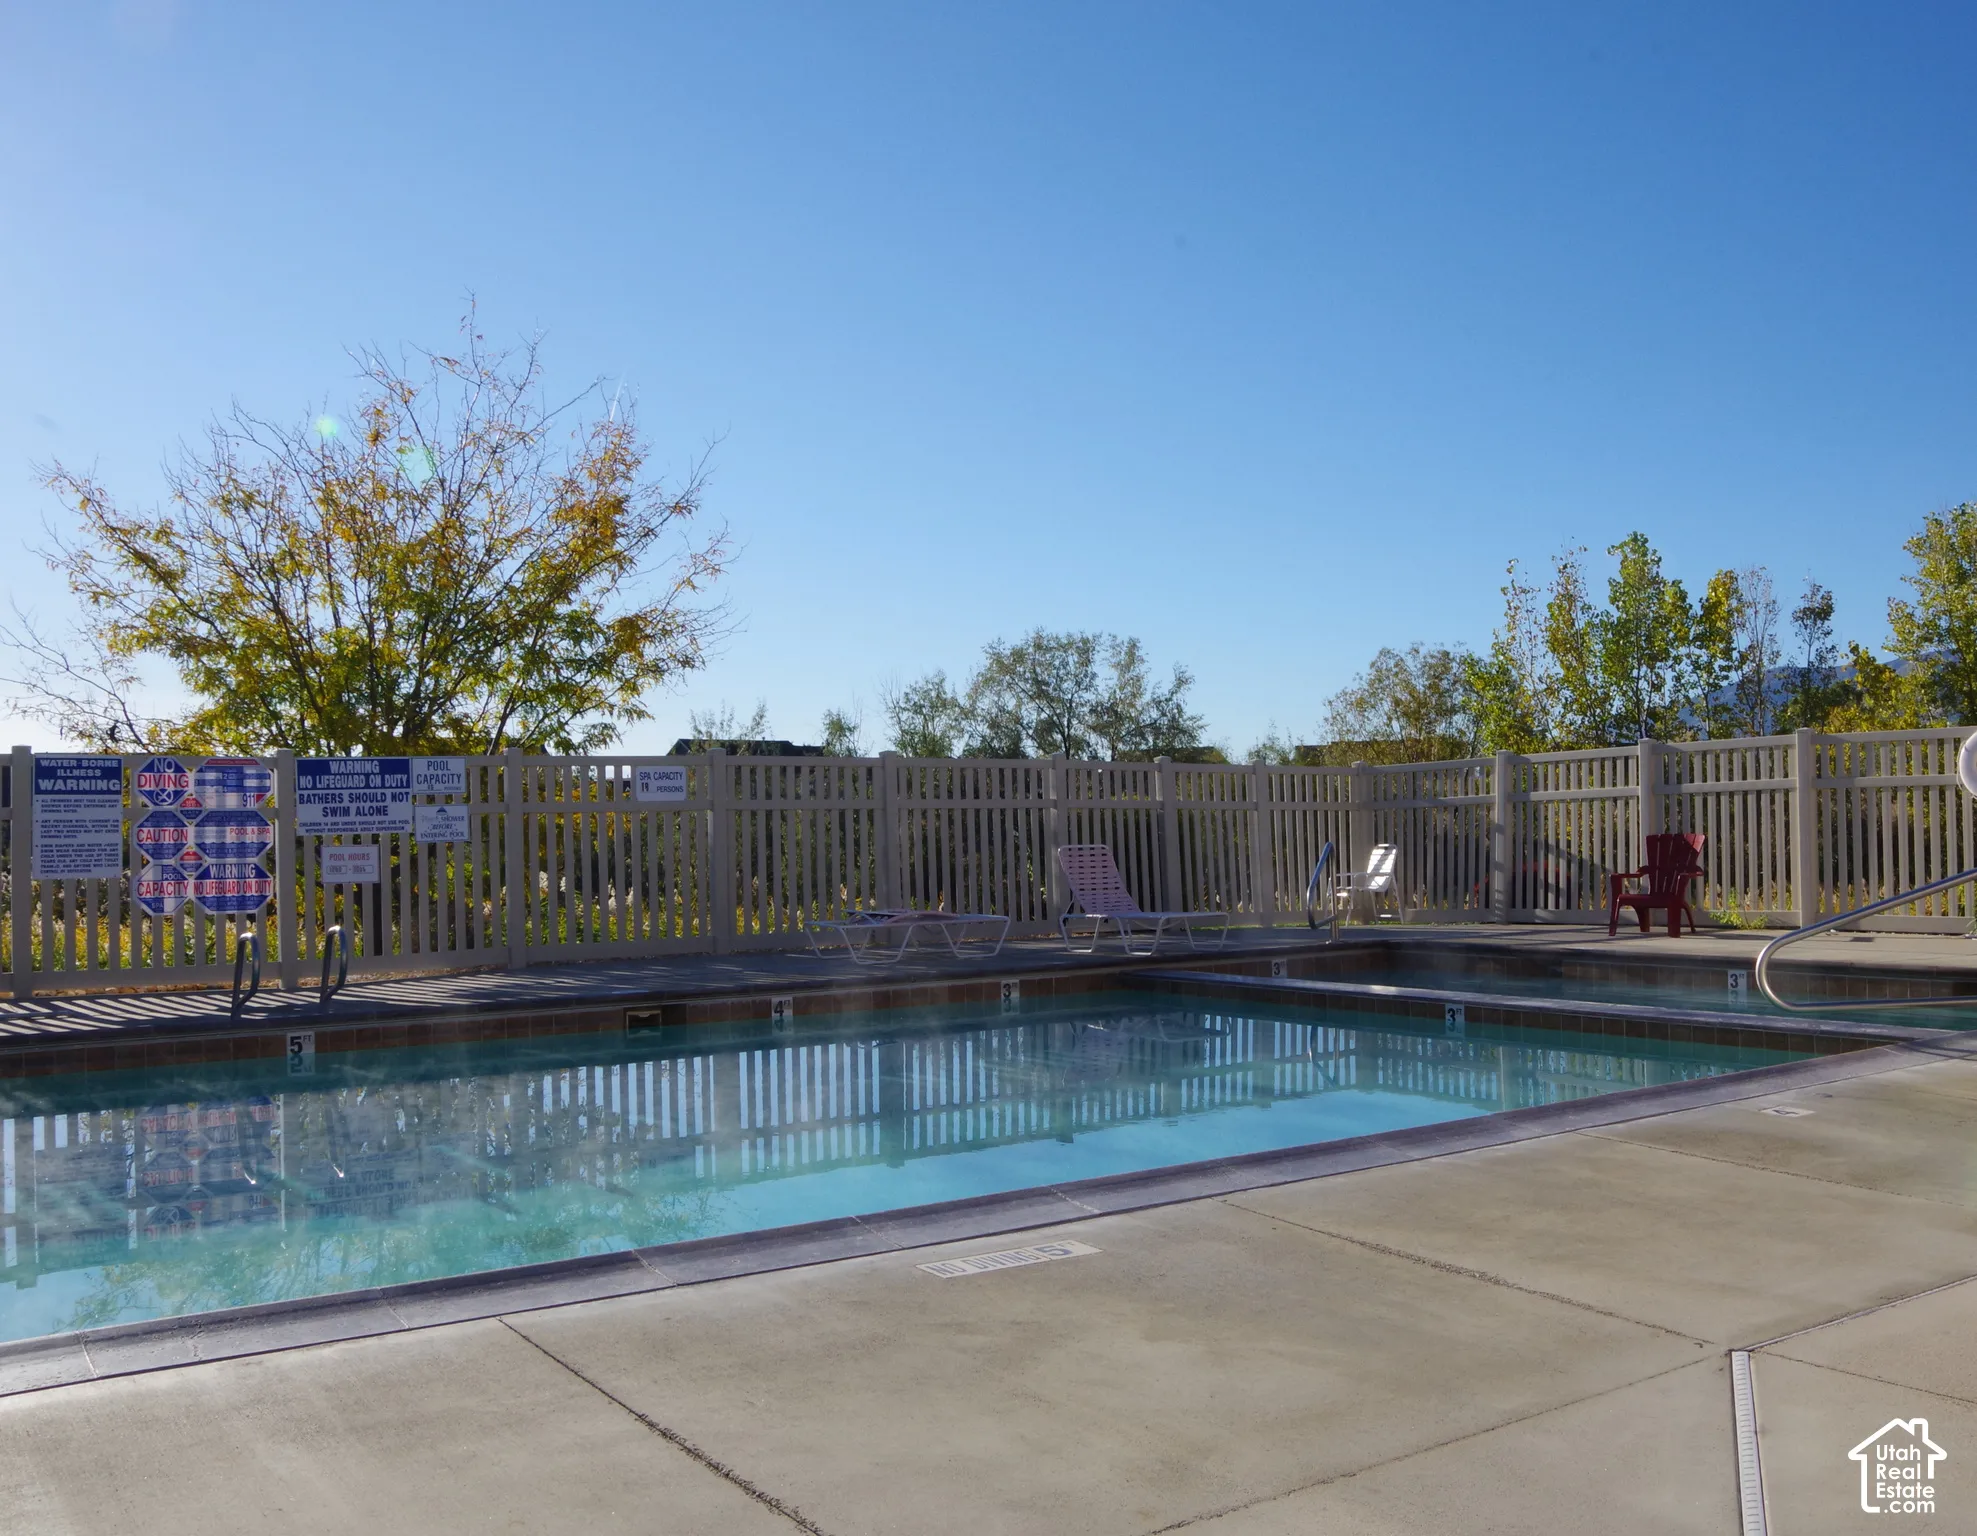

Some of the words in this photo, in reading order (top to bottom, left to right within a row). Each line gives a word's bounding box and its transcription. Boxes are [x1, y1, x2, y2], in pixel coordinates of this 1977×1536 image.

[154, 759, 175, 772] NO
[330, 761, 379, 773] WARNING
[427, 761, 451, 771] POOL
[137, 774, 189, 788] DIVING
[299, 776, 312, 788] NO
[316, 775, 365, 788] LIFEGUARD
[369, 775, 381, 787] ON
[385, 774, 407, 787] DUTY
[417, 773, 461, 784] CAPACITY
[640, 772, 651, 780] SPA
[653, 772, 683, 780] CAPACITY
[38, 780, 120, 790] WARNING
[243, 793, 256, 807] 911
[299, 793, 343, 804] BATHERS
[349, 792, 387, 803] SHOULD
[391, 792, 410, 802] NOT
[322, 806, 350, 817] SWIM
[355, 806, 388, 816] ALONE
[136, 828, 188, 842] CAUTION
[210, 864, 256, 878] WARNING
[137, 882, 189, 896] CAPACITY
[194, 882, 203, 895] NO
[206, 881, 240, 895] LIFEGUARD
[243, 881, 253, 894] ON
[255, 880, 272, 893] DUTY
[1273, 962, 1280, 976] 3
[1730, 973, 1738, 988] 3
[1003, 983, 1011, 998] 3
[774, 1000, 784, 1016] 4
[1448, 1008, 1456, 1023] 3
[290, 1036, 303, 1055] 5
[924, 1263, 967, 1275] NO
[962, 1249, 1043, 1269] DIVING
[1033, 1245, 1073, 1257] 5
